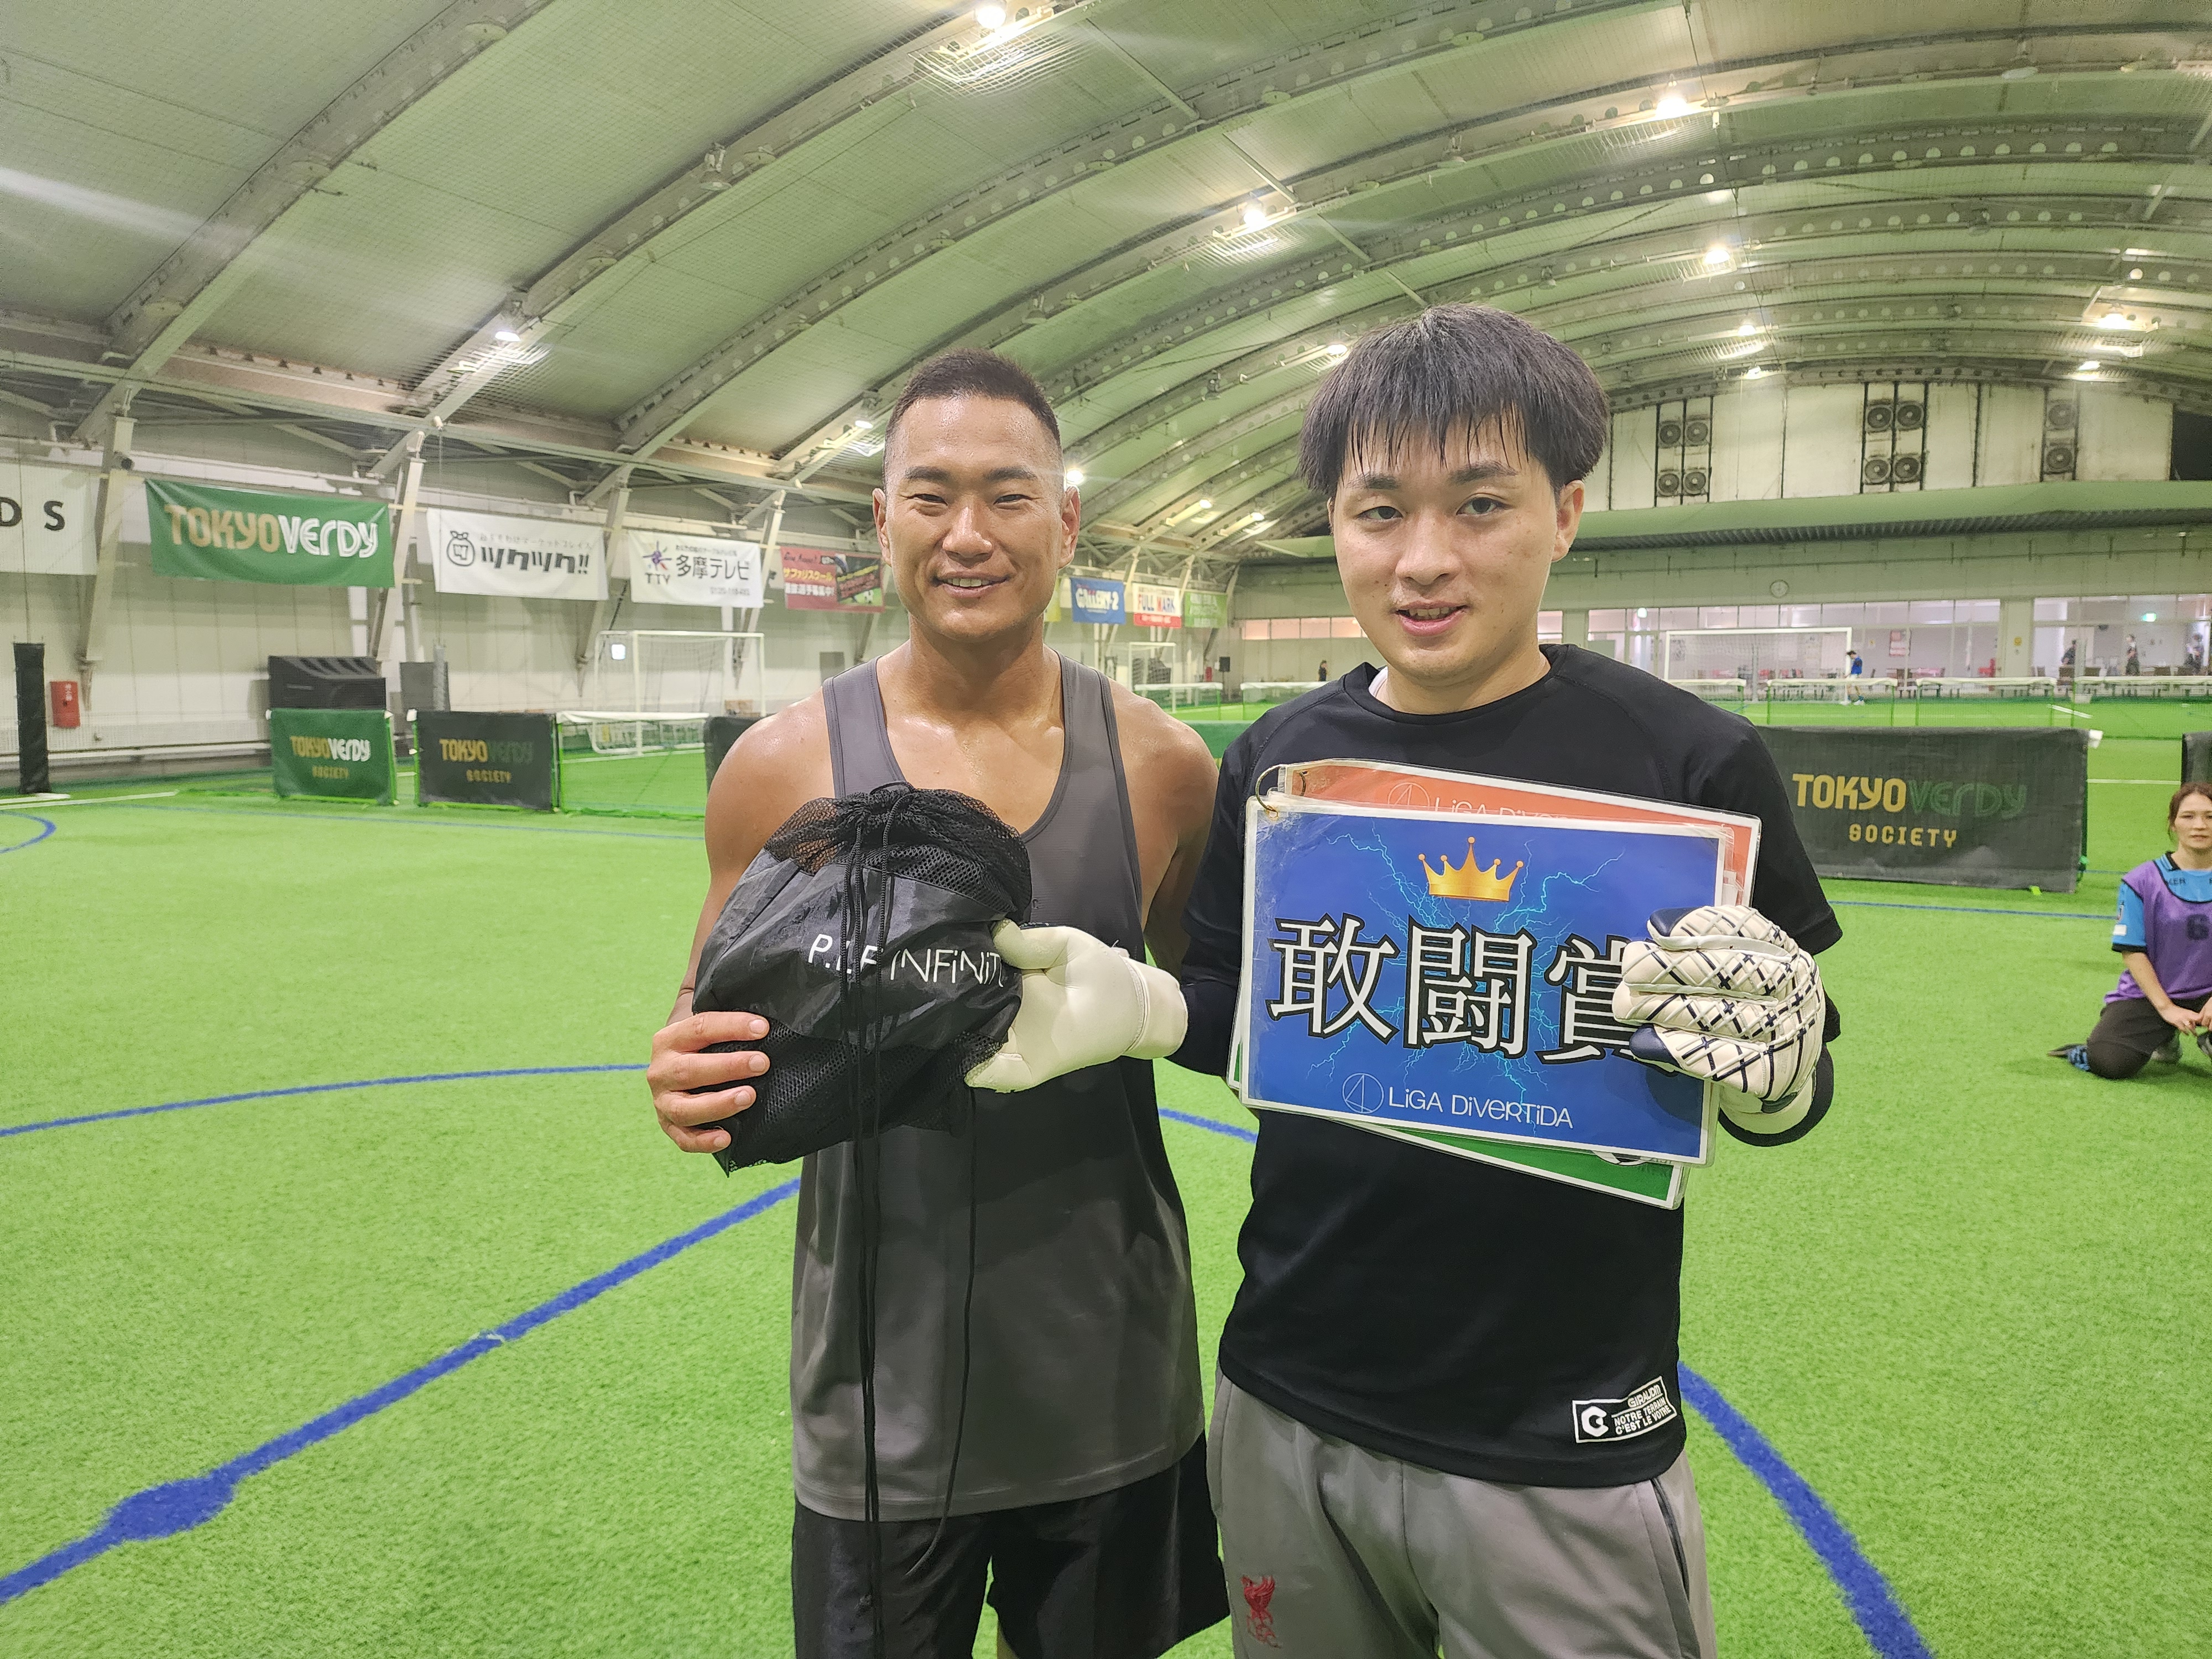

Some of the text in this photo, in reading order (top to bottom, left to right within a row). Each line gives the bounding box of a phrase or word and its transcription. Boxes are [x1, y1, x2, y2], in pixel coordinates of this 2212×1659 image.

[676, 554, 750, 581] 多摩テレビ
[1848, 823, 1958, 848] SOCIETY
[2186, 914, 2210, 940] 6
[1614, 1396, 1667, 1427] NOTRE TERRAIN
[1615, 1405, 1672, 1435] C'EST LE VOTRE
